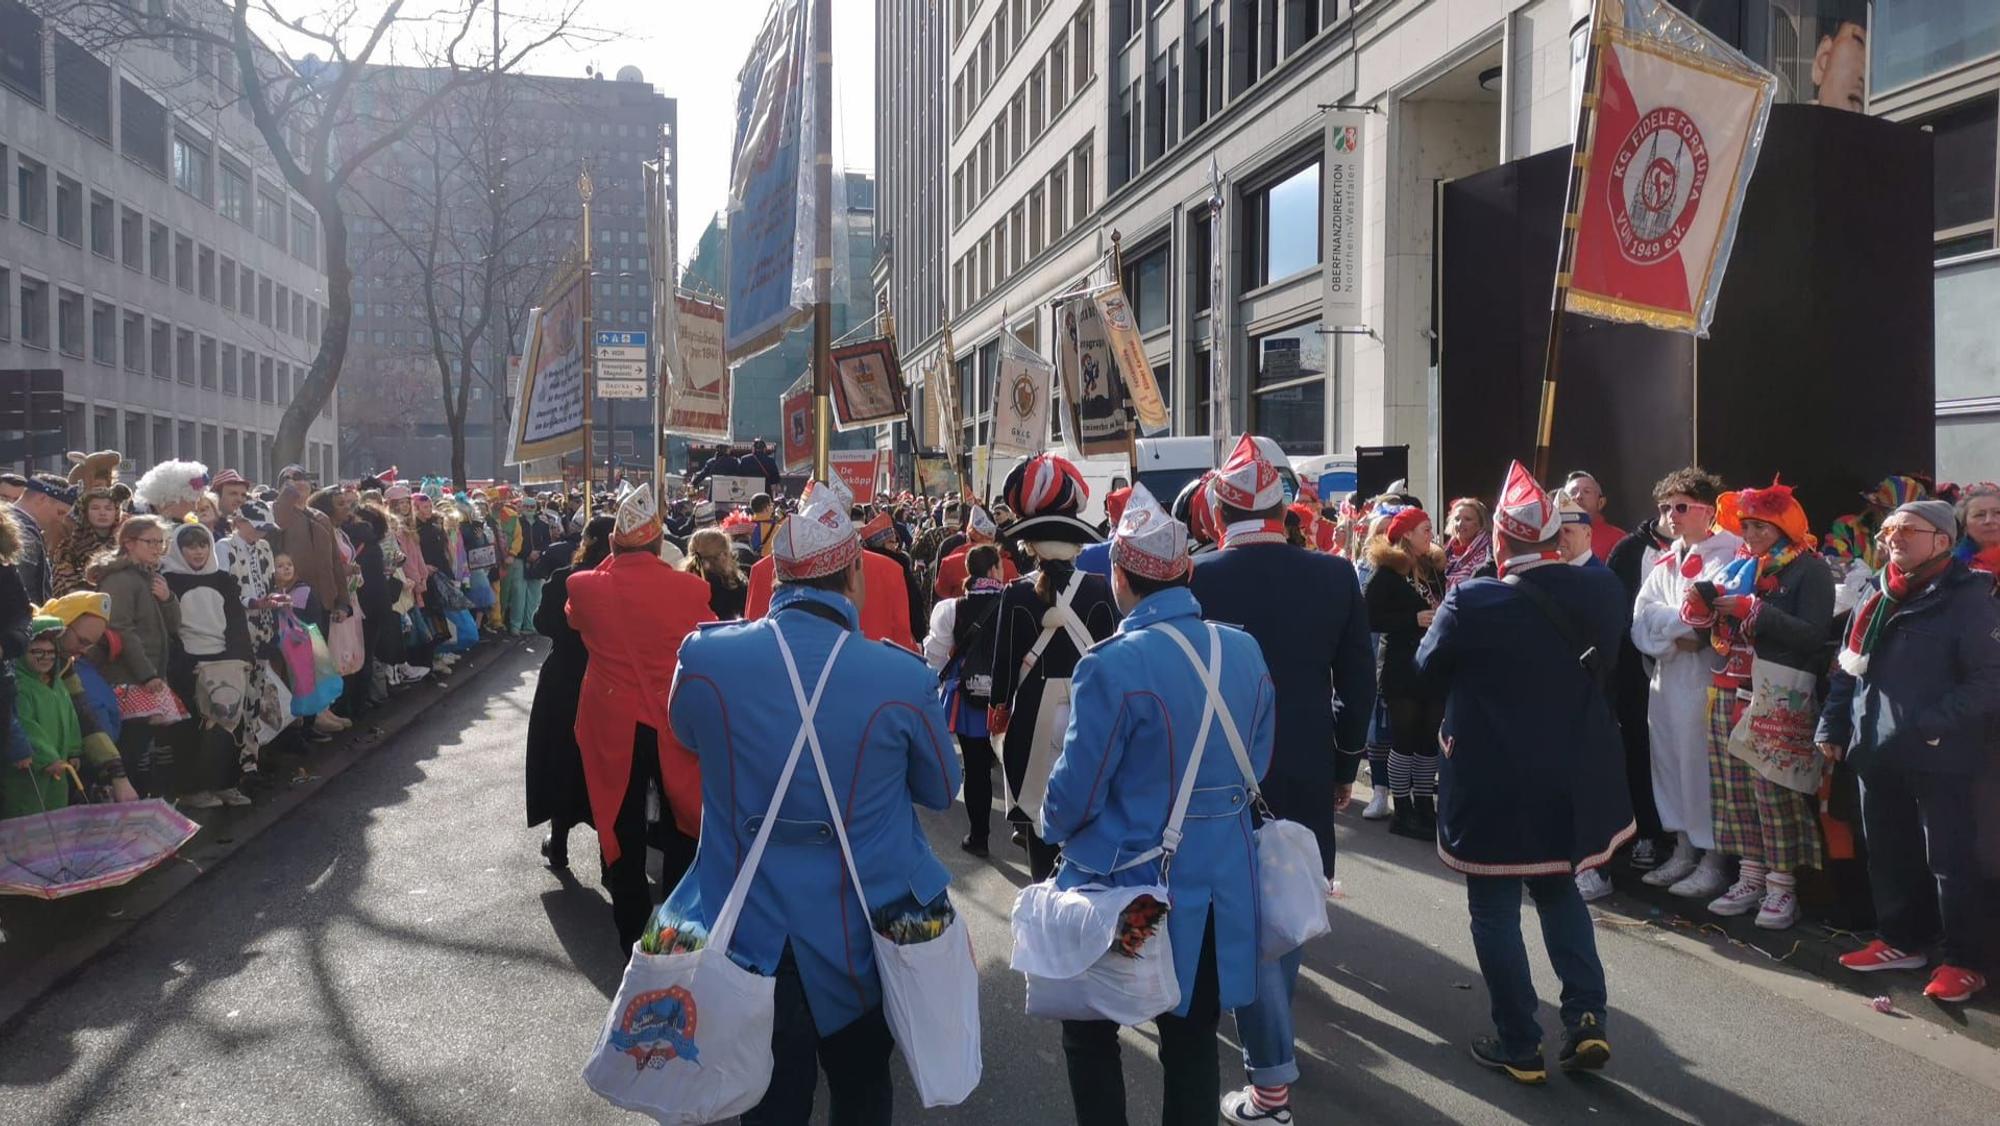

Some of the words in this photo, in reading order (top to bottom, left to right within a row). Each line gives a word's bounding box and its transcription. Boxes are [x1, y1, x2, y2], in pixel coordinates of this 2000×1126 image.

[1613, 152, 1632, 178] KG
[1631, 111, 1676, 147] FIDELE
[1676, 116, 1707, 201] FORTUNA
[1332, 164, 1343, 293] OBERFINANZDIREKTION
[1345, 163, 1357, 293] Nordrhein-Westfalen
[1616, 211, 1633, 247] VUN
[1630, 240, 1661, 257] 1949
[840, 466, 853, 475] De
